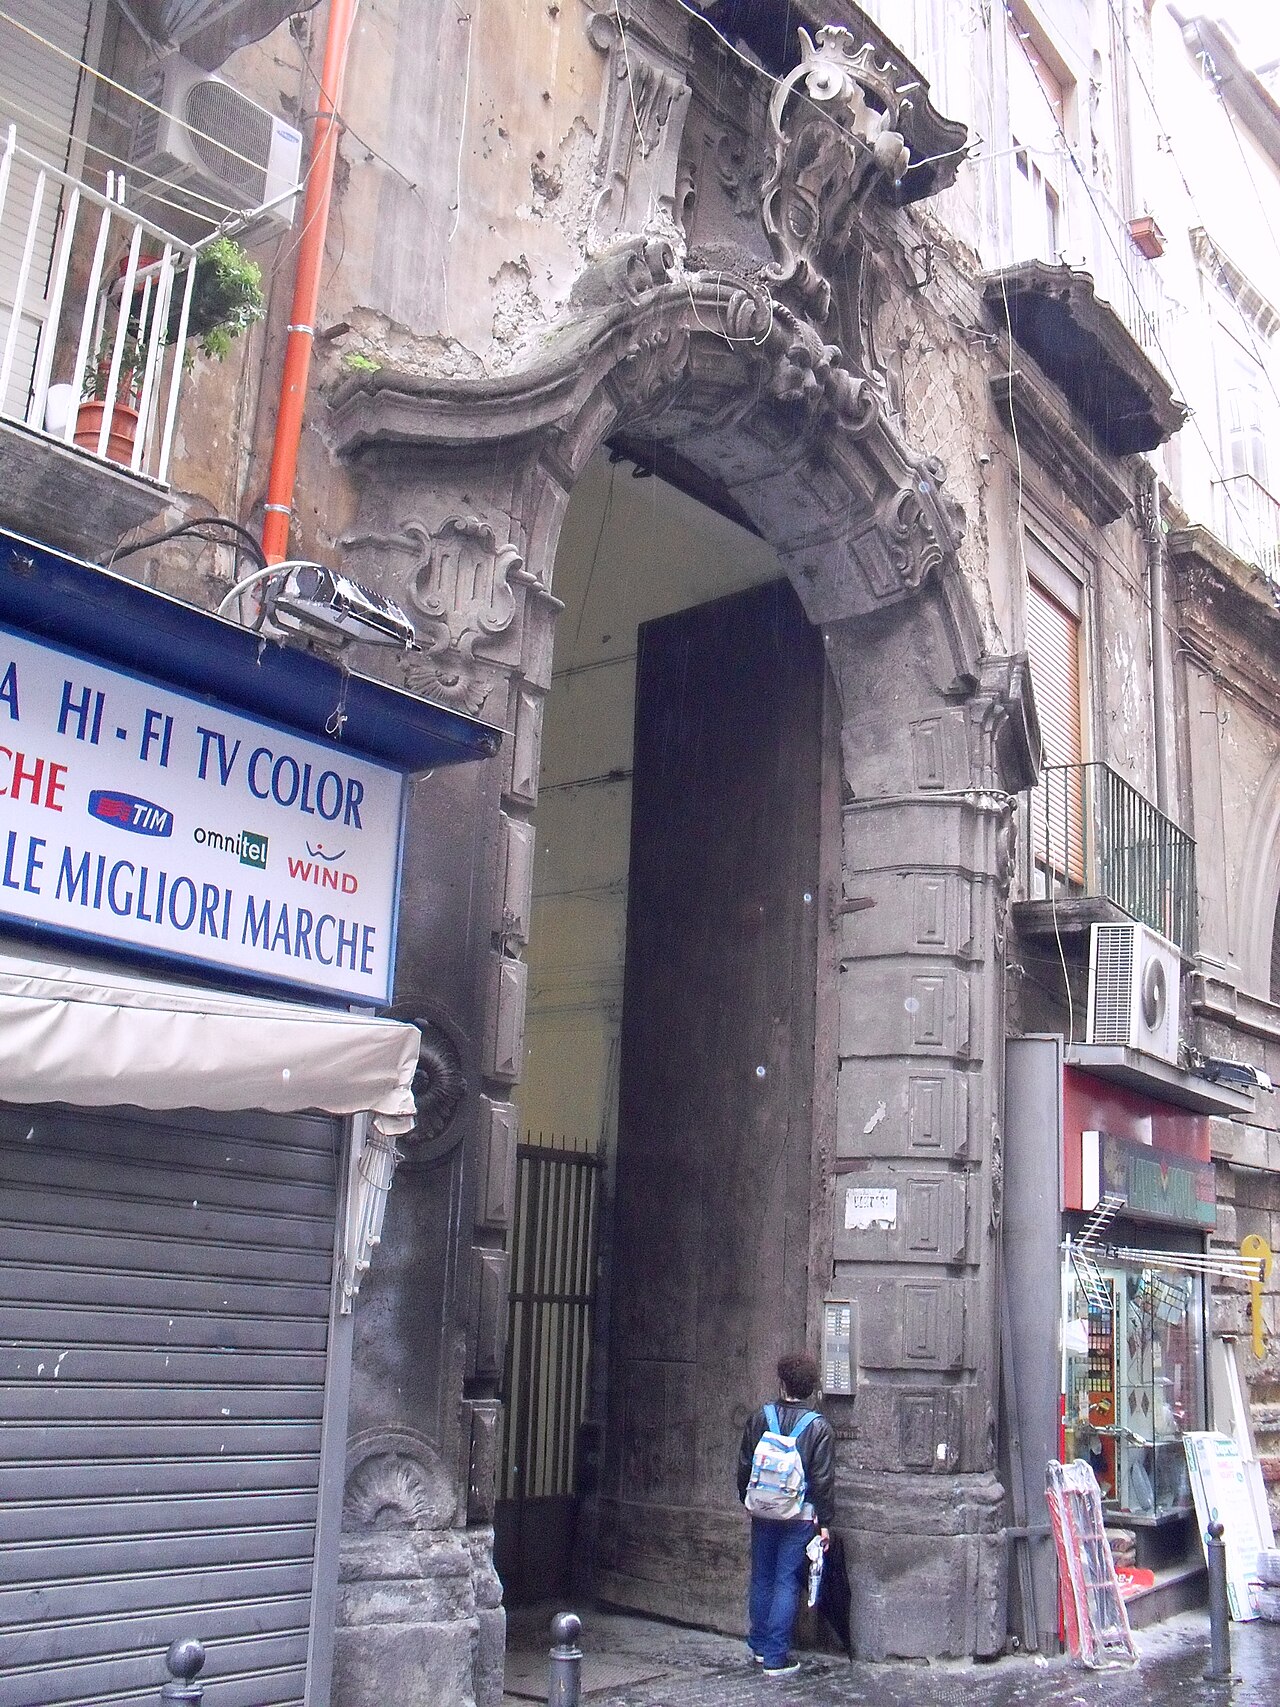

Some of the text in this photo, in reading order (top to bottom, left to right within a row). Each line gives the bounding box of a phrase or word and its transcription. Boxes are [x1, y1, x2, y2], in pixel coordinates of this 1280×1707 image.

[196, 725, 242, 787] TV
[247, 747, 364, 830] COLOR
[132, 803, 168, 832] TIM
[193, 827, 267, 864] omnitel
[287, 857, 358, 895] WIND
[2, 830, 376, 975] LE MIGLIORI MARCHE
